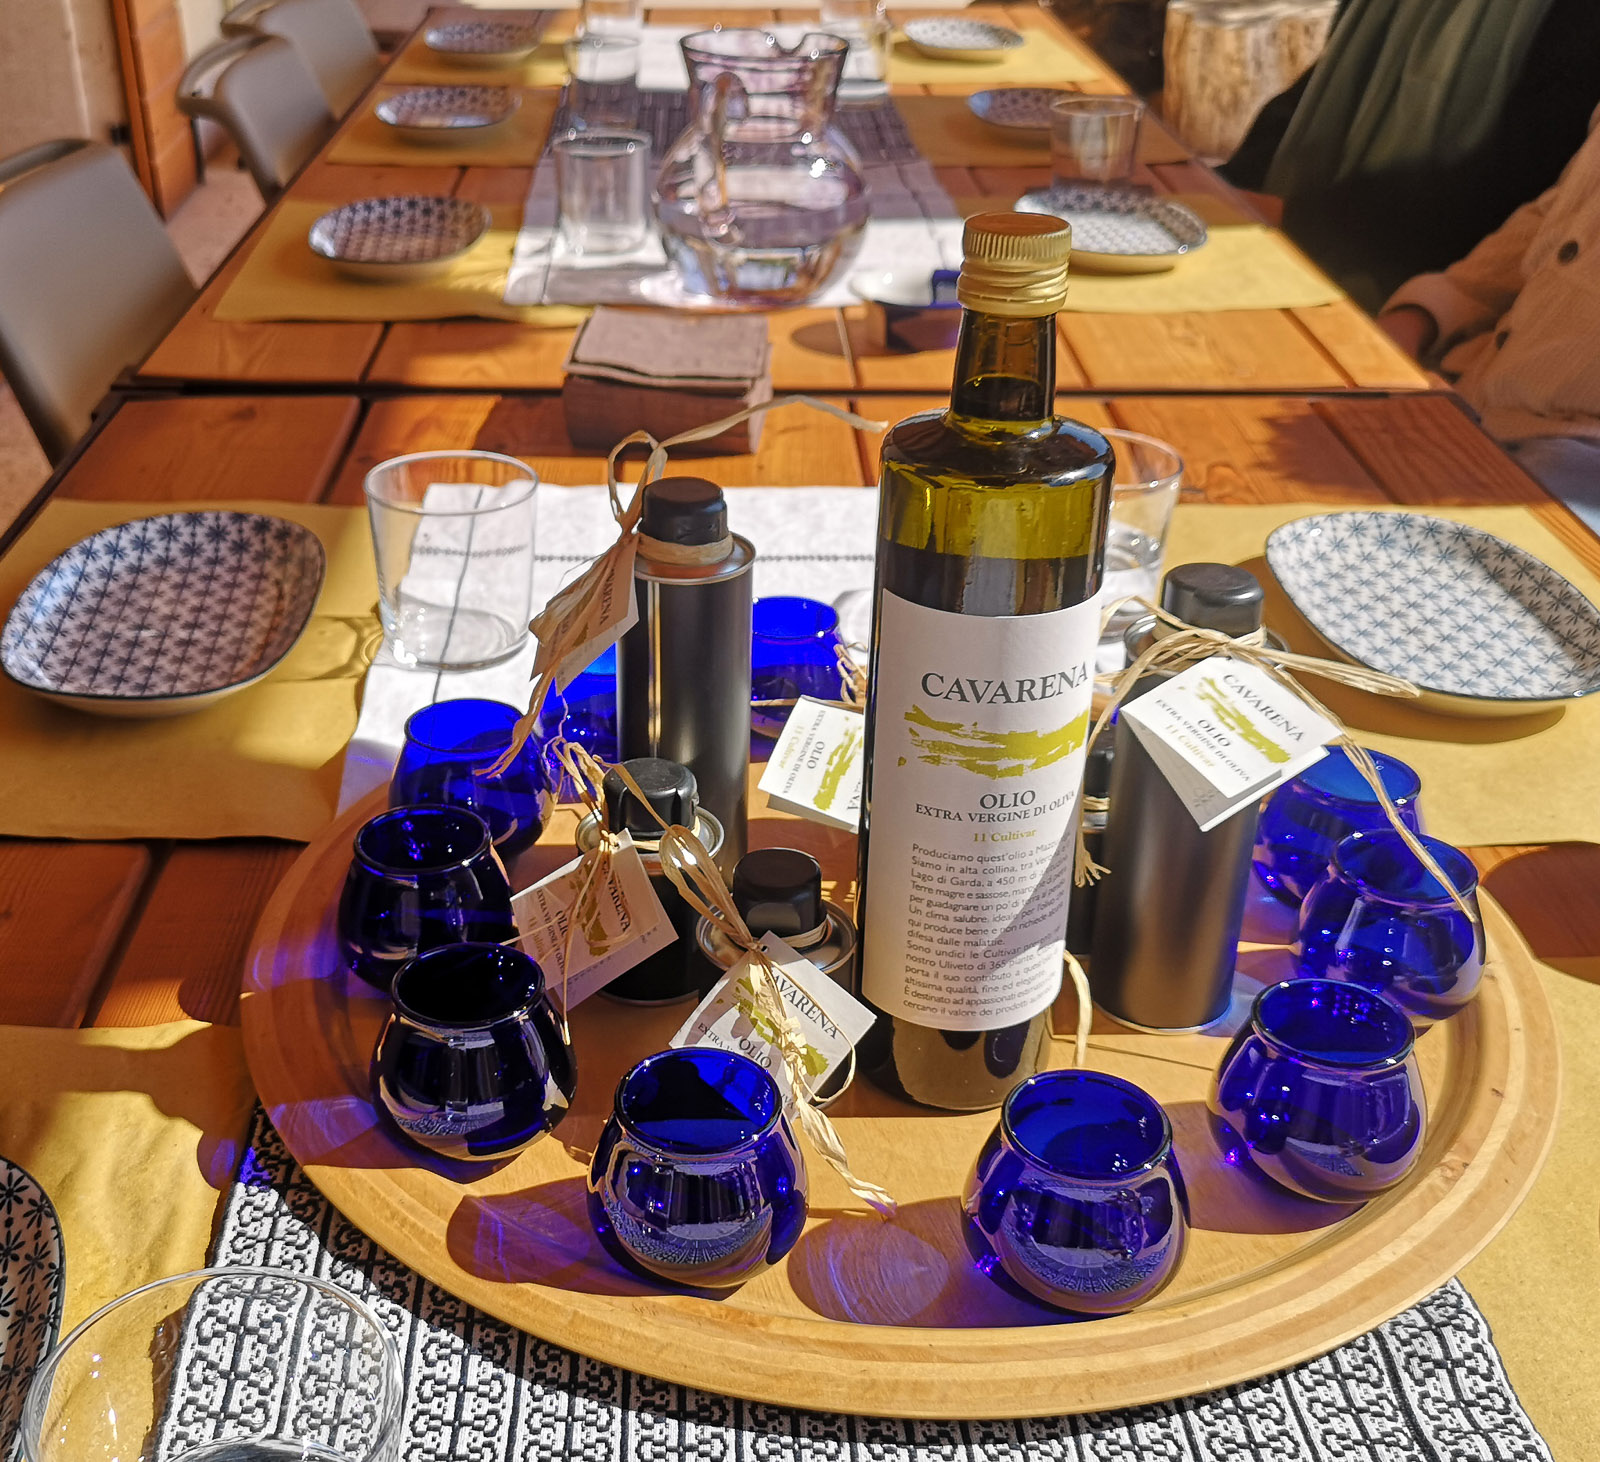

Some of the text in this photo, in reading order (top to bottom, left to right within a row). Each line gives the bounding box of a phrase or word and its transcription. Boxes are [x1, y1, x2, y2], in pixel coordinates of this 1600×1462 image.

[921, 660, 1088, 704] CAVARENA
[1222, 673, 1307, 742] CAVARENA
[1155, 698, 1251, 782] EXTRA VERGINE DI OLIVA
[1197, 718, 1232, 748] OLIO
[807, 740, 826, 770] OLIO
[1178, 734, 1217, 768] Cultivar
[915, 789, 1075, 823] EXTRA VERGINE DI OLIVA
[979, 790, 1036, 809] OLIO
[973, 833, 984, 842] 11
[991, 828, 1037, 842] Cultivar
[912, 843, 974, 862] Produciamo
[977, 850, 1026, 864] quest'olio
[911, 856, 941, 871] Siamo
[945, 863, 955, 873] in
[959, 866, 978, 875] alta
[1021, 862, 1033, 871] tra
[911, 868, 933, 882] Lago
[937, 875, 946, 884] di
[996, 876, 1015, 886] 450
[911, 880, 933, 894] Terre
[936, 889, 965, 899] magre
[537, 889, 547, 913] EXTRA
[910, 894, 925, 903] per
[926, 899, 979, 912] guadagnare
[908, 904, 922, 916] Un
[926, 910, 949, 921] clima
[1021, 908, 1035, 919] per
[908, 918, 921, 928] qui
[923, 923, 963, 935] produce
[965, 927, 989, 935] bene
[907, 930, 934, 942] difesa
[937, 936, 960, 947] dalle
[907, 940, 931, 954] Sono
[935, 949, 965, 959] undici
[970, 951, 979, 959] le
[983, 947, 1021, 958] Cultivar
[906, 953, 936, 967] nostro
[938, 960, 974, 971] Uliveto
[977, 962, 986, 971] di
[989, 960, 1006, 970] 365
[905, 965, 930, 977] porta
[934, 971, 939, 979] il
[964, 972, 1012, 982] contributo
[905, 976, 942, 991] altissima
[982, 985, 999, 993] fine
[1002, 982, 1013, 990] ed
[904, 984, 910, 995] È
[911, 990, 951, 1004] destinato
[952, 997, 963, 1005] ad
[965, 993, 1016, 1007] appassionati
[903, 999, 938, 1013] cercano
[941, 1007, 946, 1015] il
[948, 1008, 977, 1016] valore
[979, 1006, 993, 1016] dei
[697, 1022, 724, 1048] EXTRA
[738, 1037, 772, 1069] OLIO
